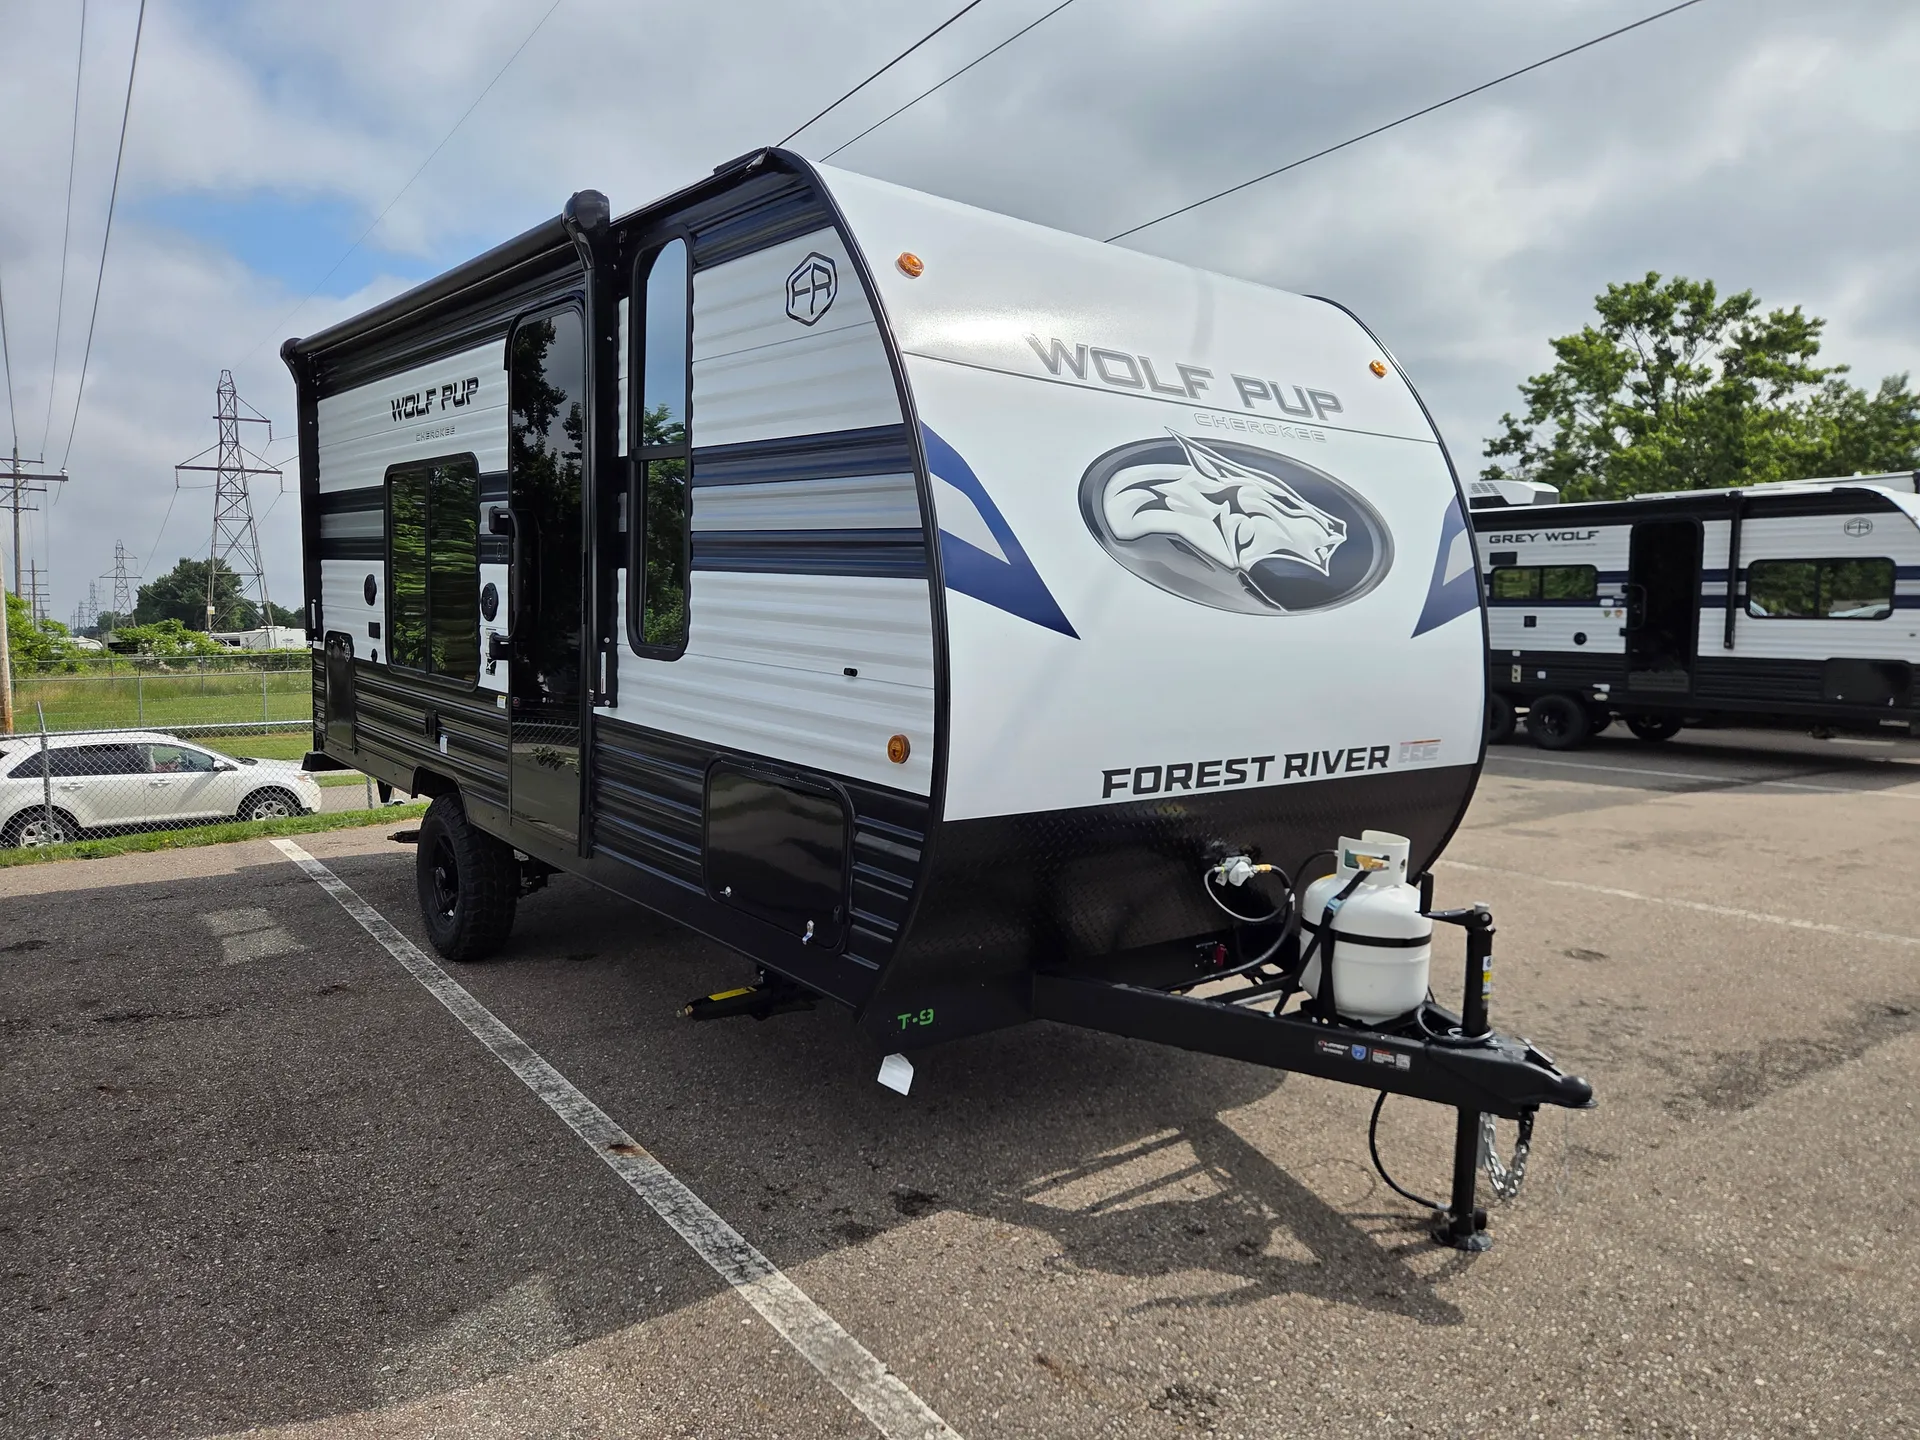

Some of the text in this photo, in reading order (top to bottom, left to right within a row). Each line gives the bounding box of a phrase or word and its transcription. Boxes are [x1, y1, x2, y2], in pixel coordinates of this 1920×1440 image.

[390, 376, 479, 422] WOLF PUP
[1025, 333, 1344, 421] WOLF PUP
[1193, 412, 1327, 442] CHEROKEE
[1489, 530, 1600, 544] GREY WOLF
[1101, 755, 1276, 799] FOREST
[1283, 745, 1391, 780] RIVER
